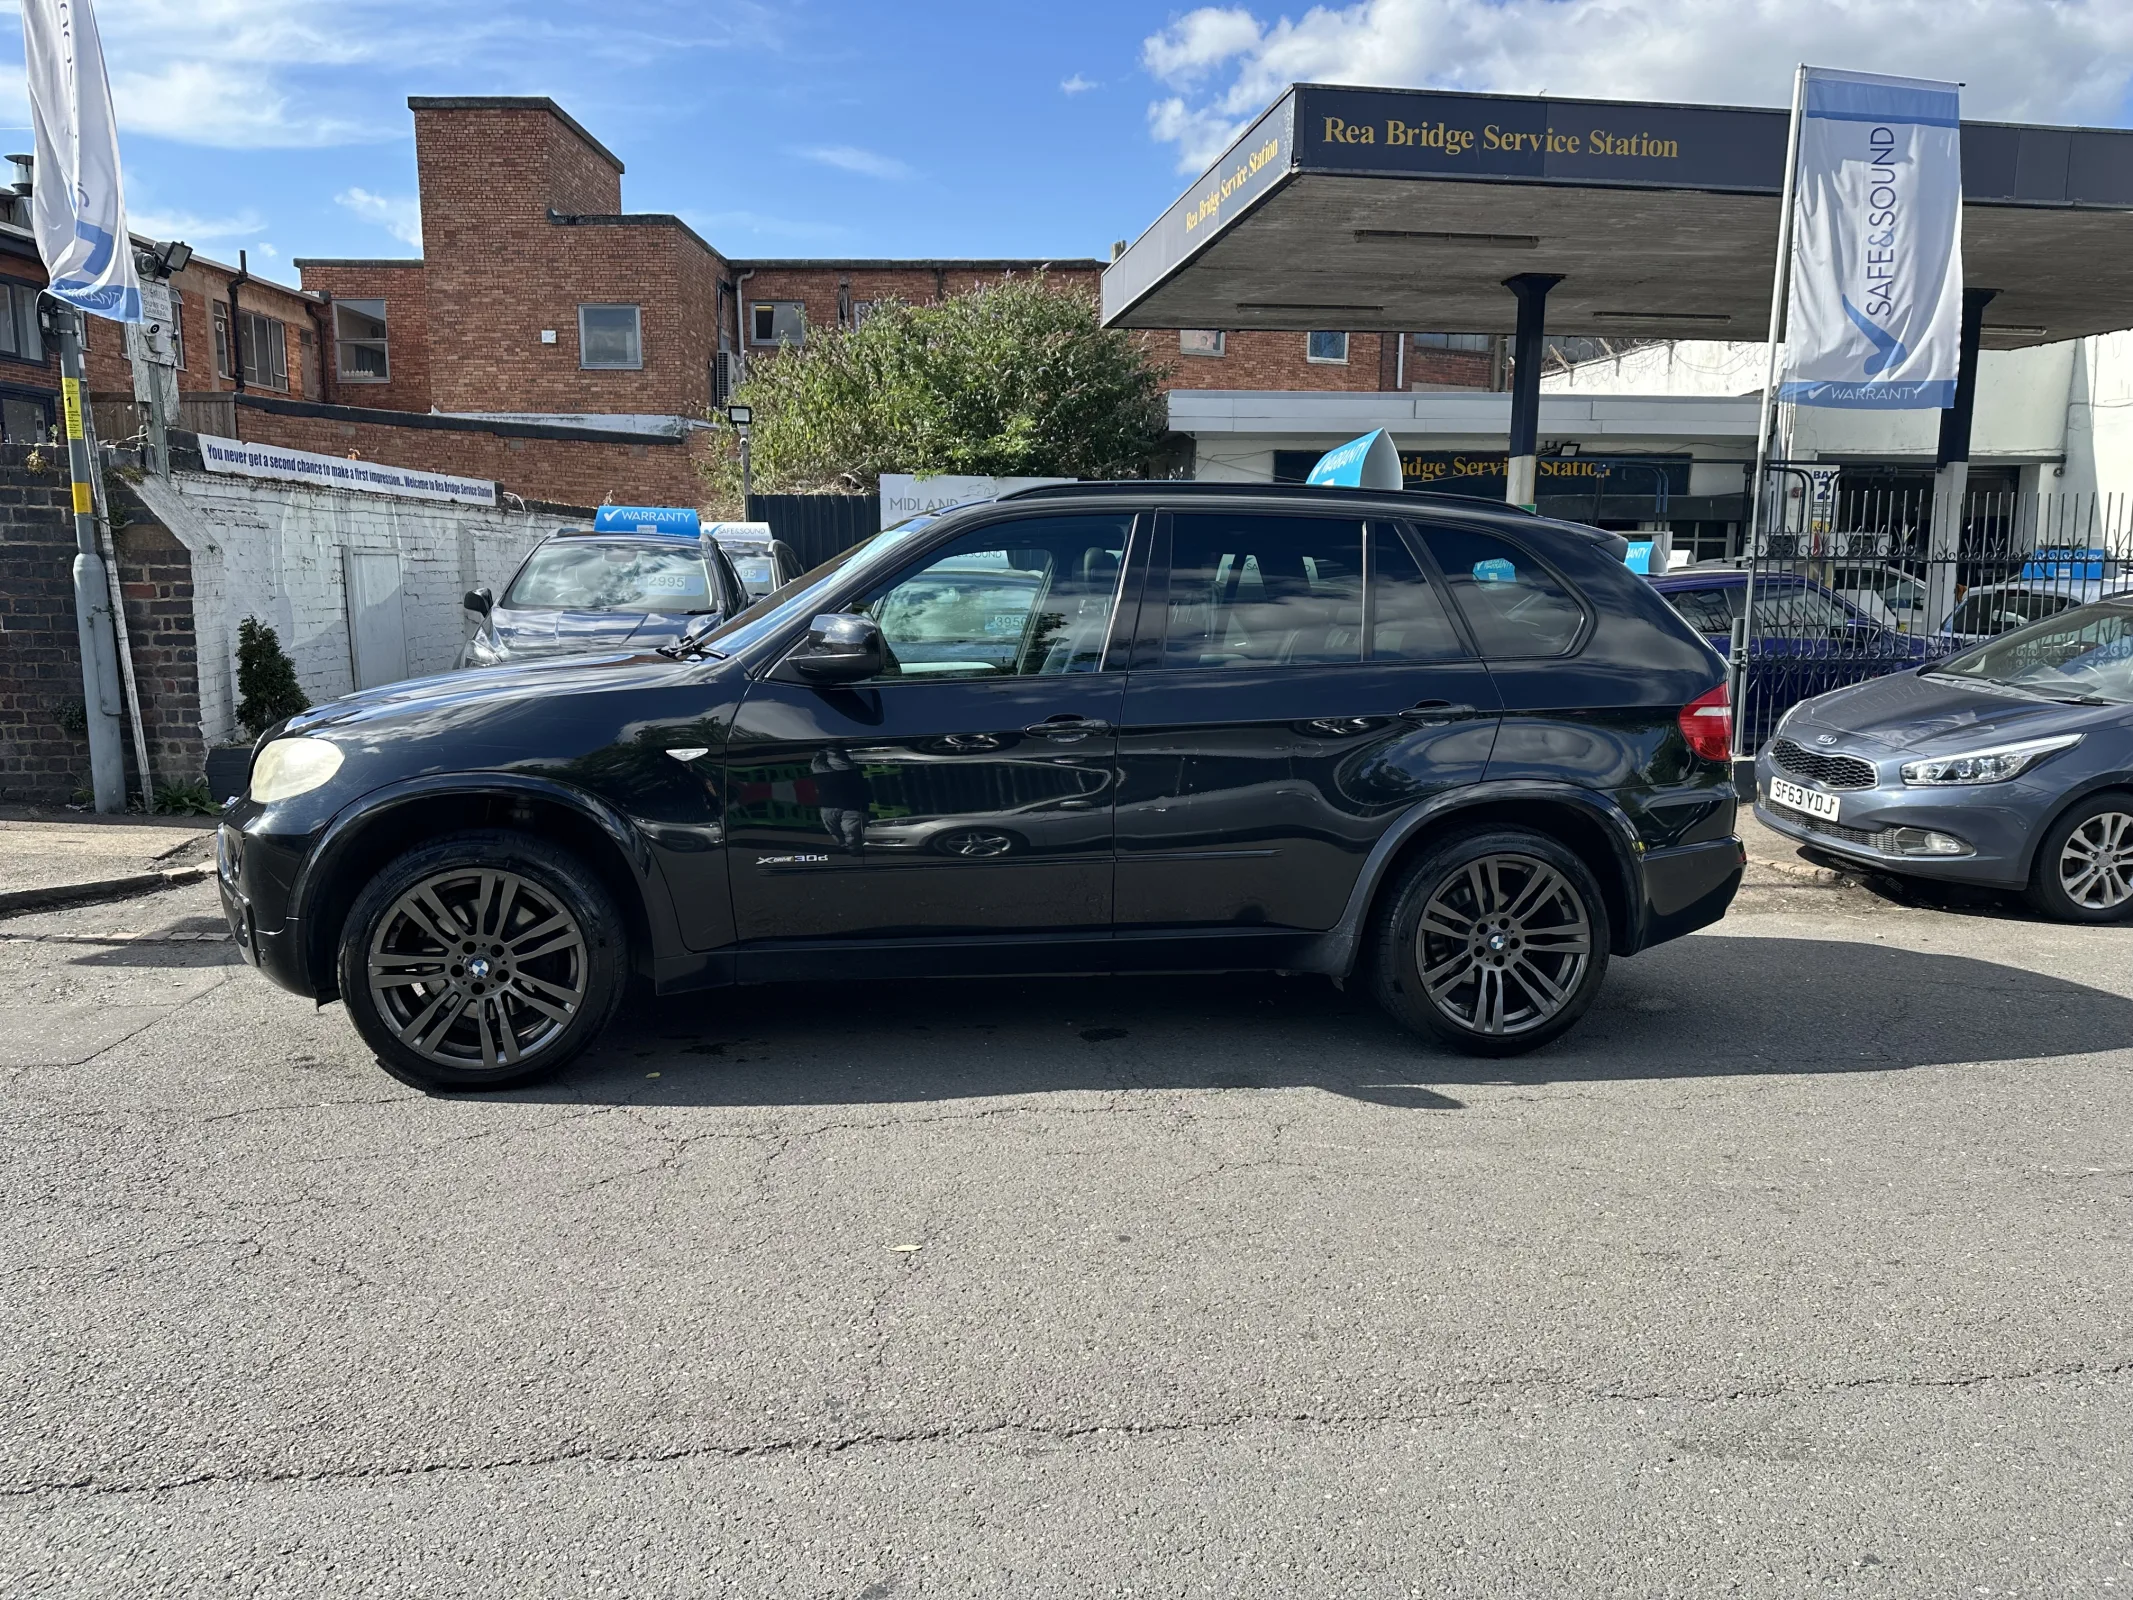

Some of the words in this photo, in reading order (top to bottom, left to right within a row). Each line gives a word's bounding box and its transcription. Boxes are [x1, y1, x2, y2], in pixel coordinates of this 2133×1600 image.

[1322, 116, 1375, 144] Rea
[1384, 119, 1474, 155] Bridge
[1483, 124, 1580, 153] Service
[1588, 129, 1679, 158] Station
[1186, 211, 1198, 233] Rea
[1199, 190, 1219, 222] Bridge
[1220, 165, 1248, 202] Service
[1248, 138, 1278, 178] Station
[1866, 126, 1897, 317] SAFE&SOUND
[1831, 386, 1922, 401] WARRANTY
[206, 443, 223, 461] You
[224, 448, 247, 464] never
[248, 453, 262, 467] get
[263, 455, 269, 468] a
[269, 456, 296, 472] second
[296, 460, 323, 475] chance
[323, 464, 331, 476] to
[331, 465, 349, 478] make
[354, 468, 369, 481] first
[404, 475, 428, 490] Welcome
[444, 481, 460, 495] Bridge
[460, 483, 477, 496] Service
[477, 484, 493, 499] Station
[1321, 440, 1370, 475] WARRANTY
[1401, 456, 1446, 481] idge
[1452, 456, 1509, 476] Servi
[1540, 460, 1611, 477] Statio
[1816, 481, 1832, 500] 2
[621, 510, 691, 523] WARRANTY
[717, 527, 766, 535] SAFE&SOUND
[648, 576, 685, 588] 2995
[1775, 780, 1803, 806] SF63
[1806, 789, 1834, 815] YDJ
